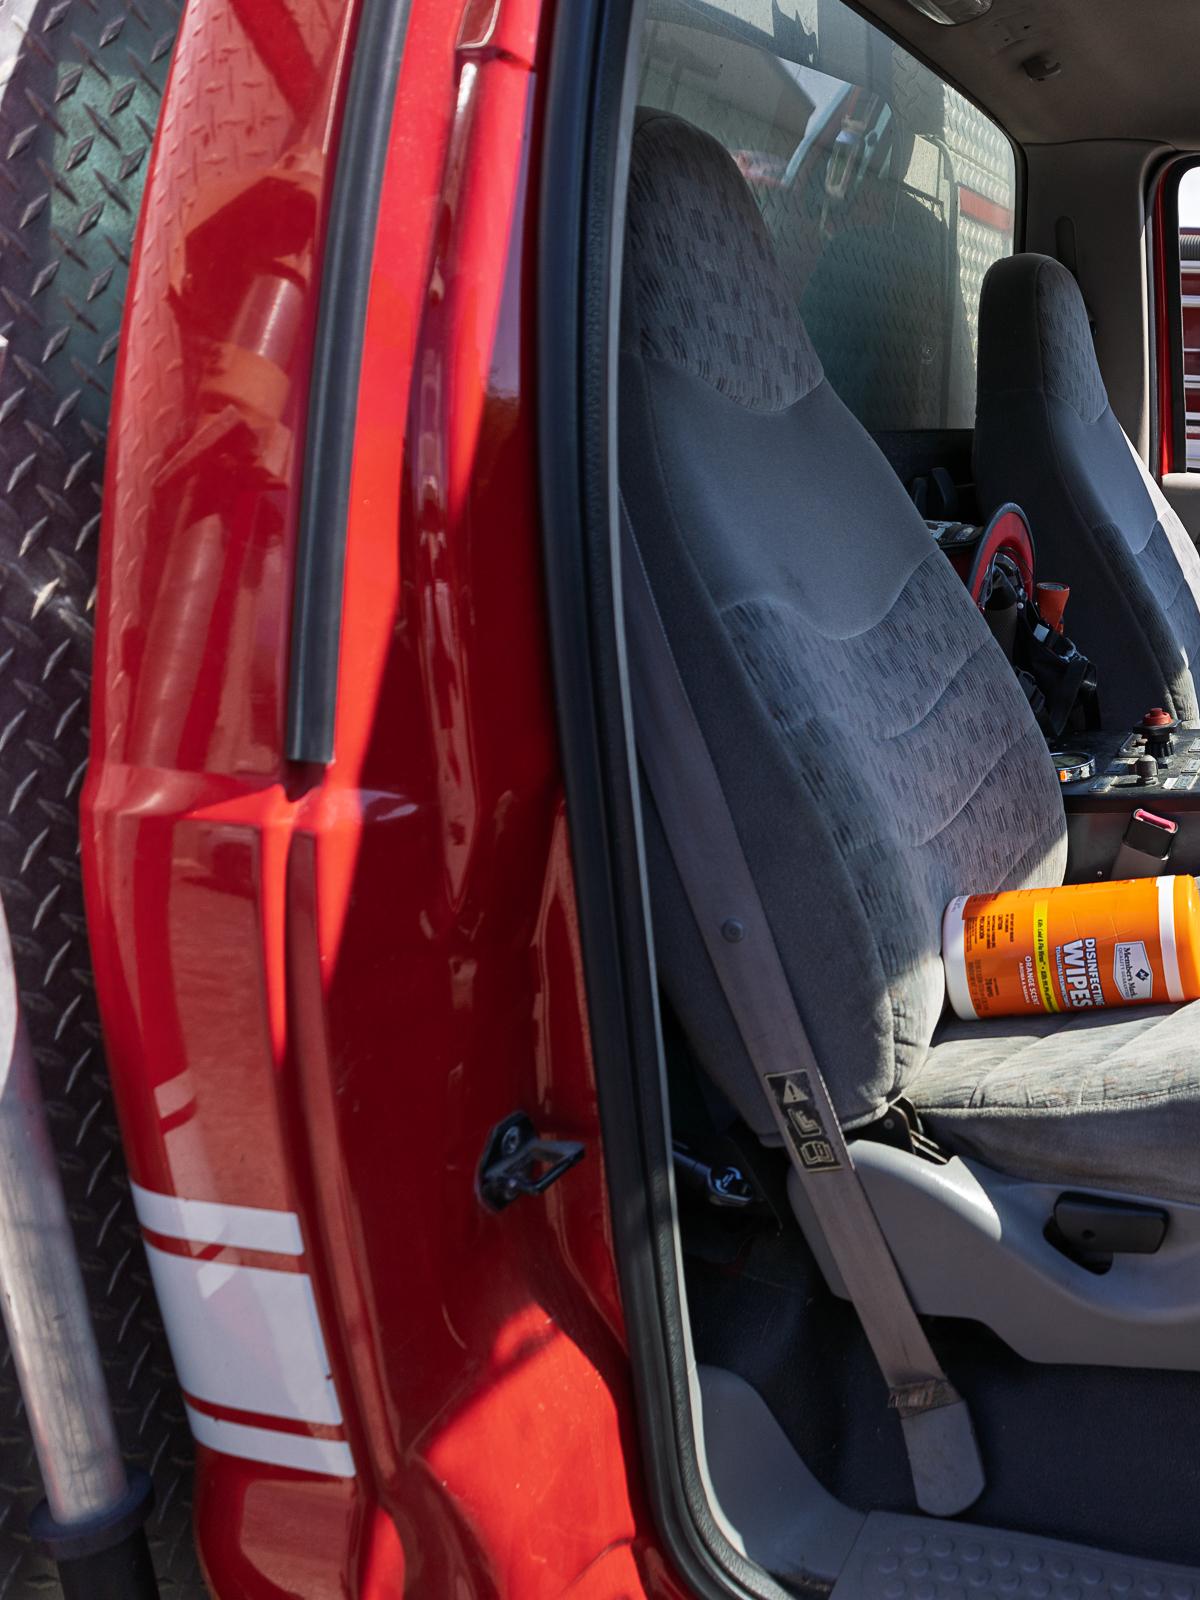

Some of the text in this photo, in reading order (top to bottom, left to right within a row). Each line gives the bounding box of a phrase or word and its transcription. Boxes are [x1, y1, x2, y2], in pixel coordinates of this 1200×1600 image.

[1025, 955, 1040, 1005] ORANGE SCENT
[1063, 939, 1093, 1007] WIPES
[1085, 938, 1105, 1006] DISINFECTING
[1123, 947, 1134, 981] Member's
